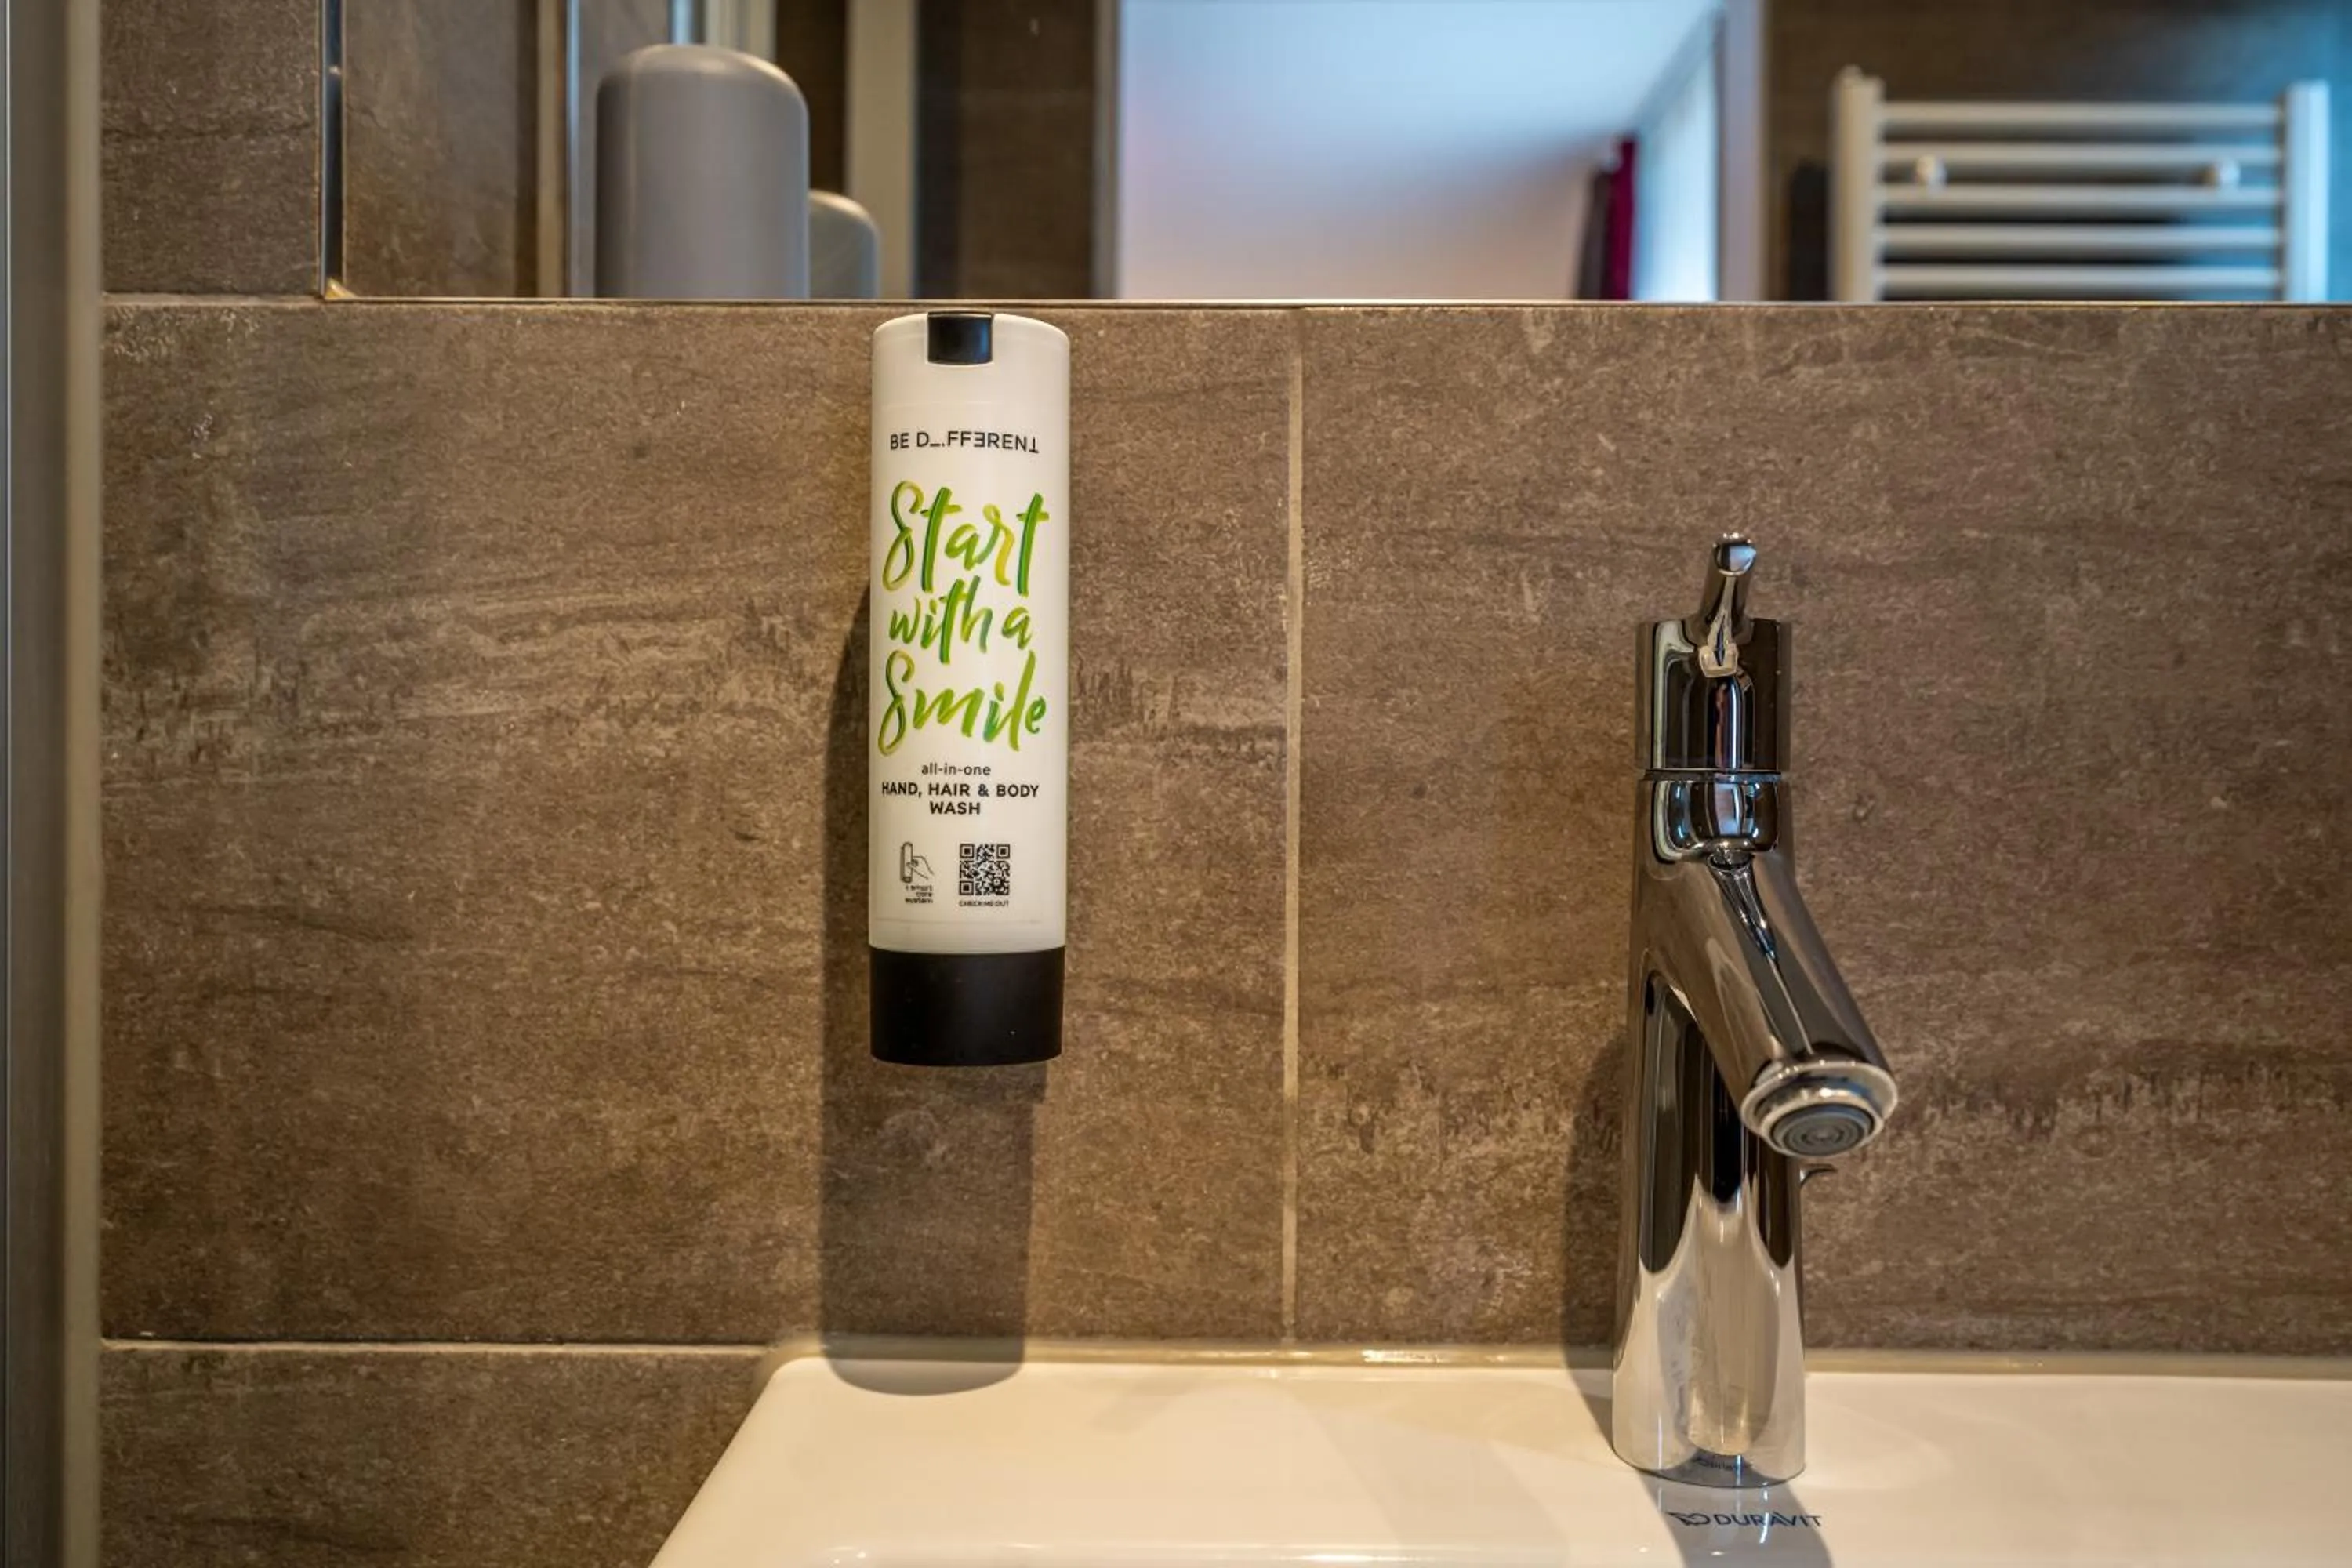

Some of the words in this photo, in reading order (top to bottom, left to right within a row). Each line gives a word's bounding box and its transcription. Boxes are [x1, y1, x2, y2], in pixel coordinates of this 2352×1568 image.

[890, 432, 910, 451] BE
[882, 479, 1050, 598] Start
[888, 575, 993, 665] with
[1000, 605, 1033, 651] a
[877, 649, 1047, 757] Smile
[921, 762, 992, 775] all-in-one
[882, 782, 923, 798] HAND,
[928, 782, 971, 797] HAIR
[978, 783, 989, 797] &
[996, 784, 1039, 797] BODY
[929, 800, 981, 815] WASH
[1712, 1512, 1822, 1527] DURAVIT
